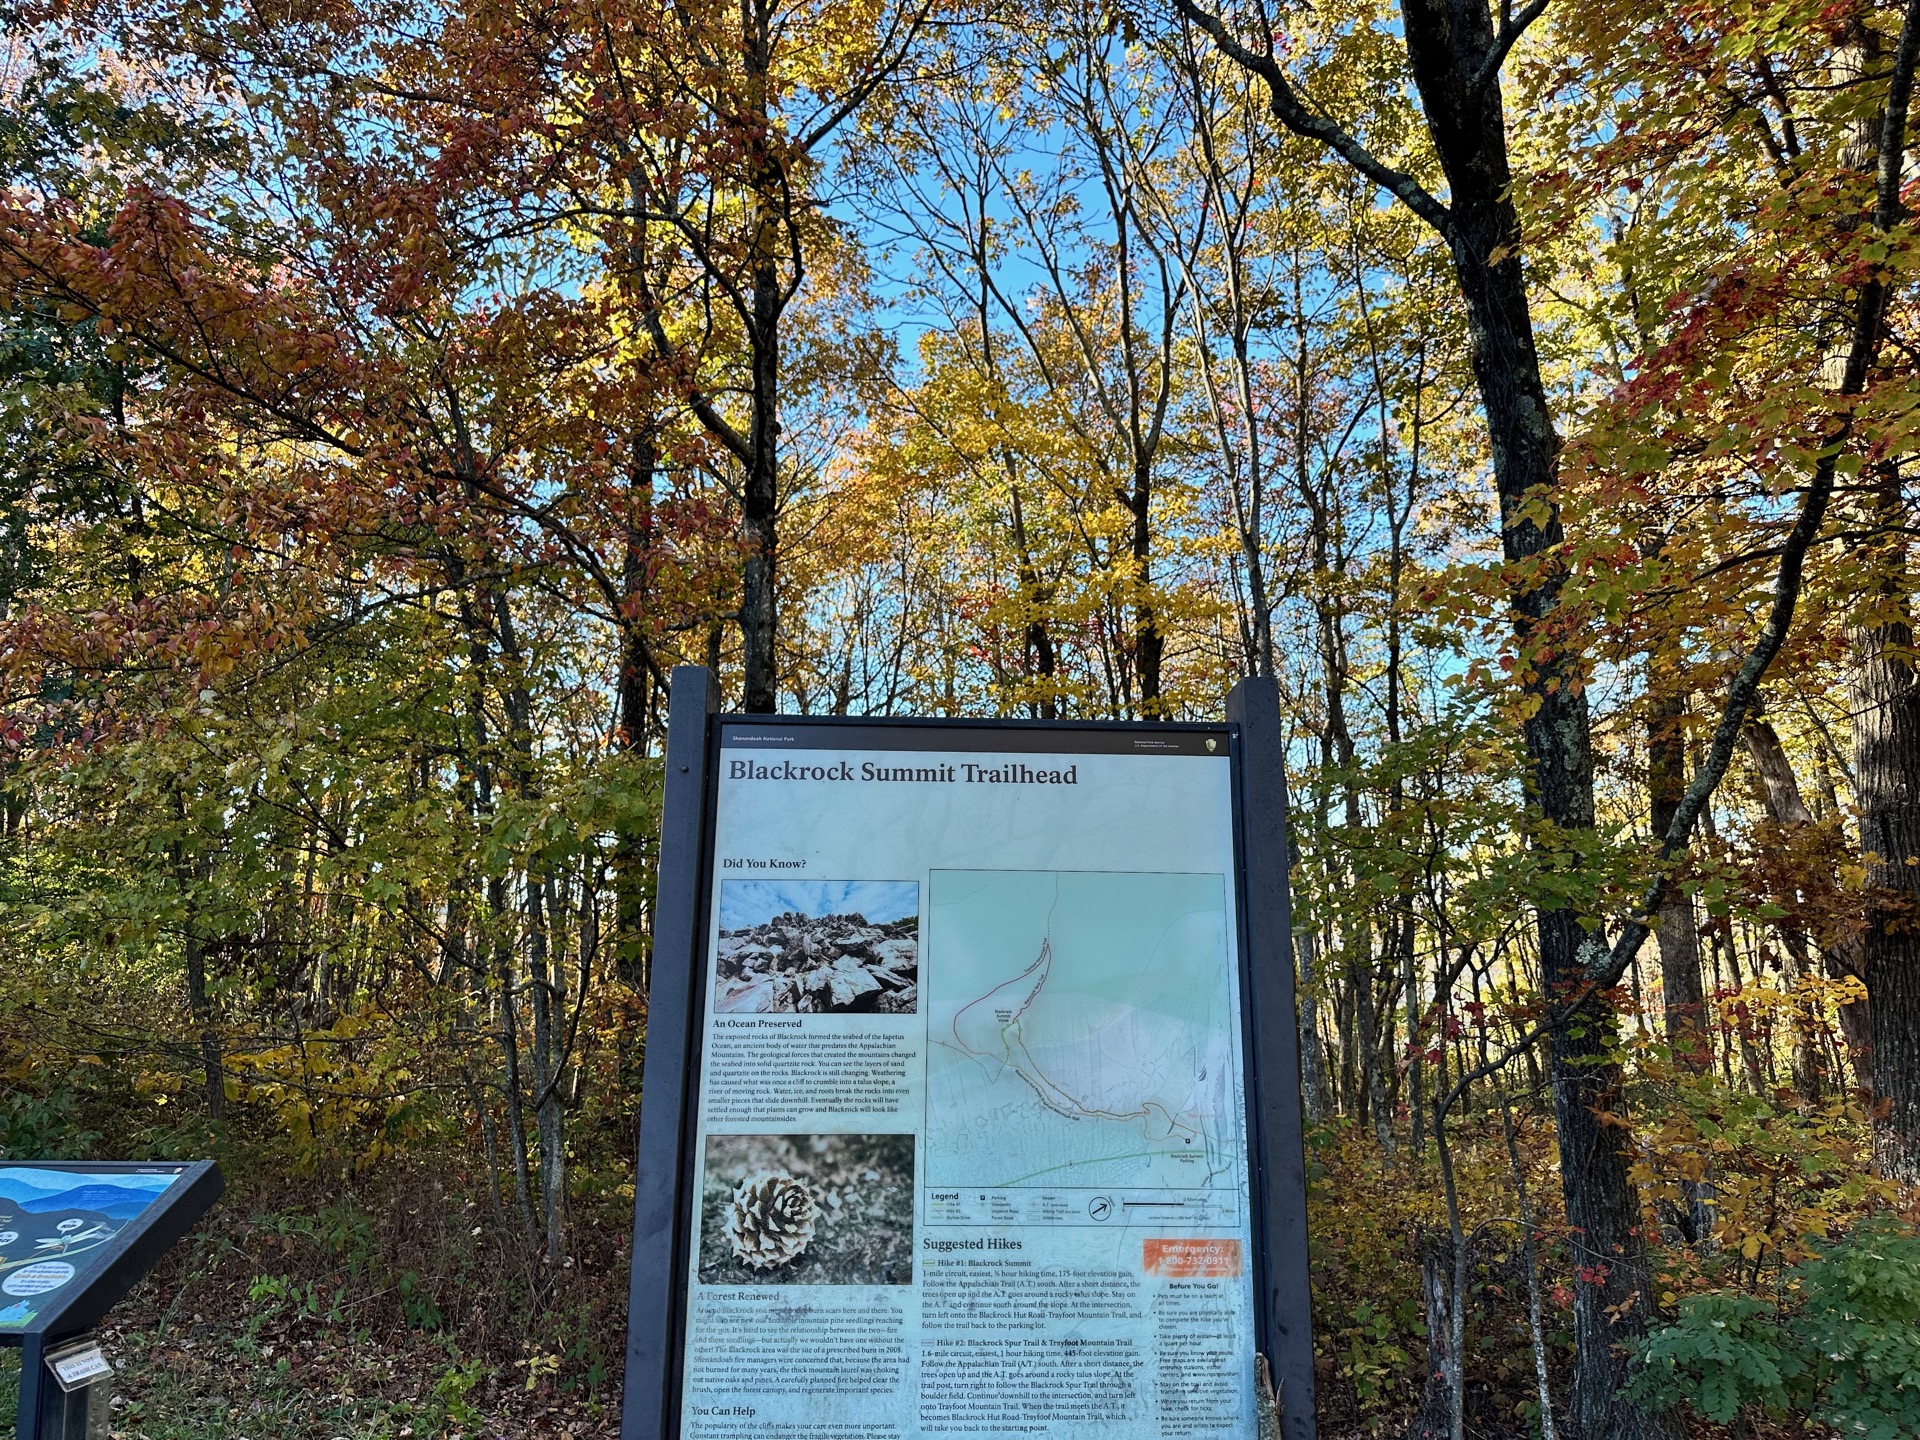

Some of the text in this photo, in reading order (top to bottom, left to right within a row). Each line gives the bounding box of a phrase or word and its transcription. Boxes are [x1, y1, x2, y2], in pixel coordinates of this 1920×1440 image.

[729, 761, 1079, 784] Blackrock Summit Trailhead
[723, 859, 806, 868] Did You Know?
[712, 1019, 802, 1028] An Ocean Preserved
[725, 1033, 750, 1041] exposed
[882, 1034, 904, 1042] Iapetus
[765, 1042, 781, 1050] body
[821, 1042, 847, 1050] predates
[859, 1042, 896, 1051] Appalachian
[759, 1051, 790, 1059] geological
[890, 1051, 916, 1060] changed
[923, 1239, 1022, 1252] Suggested Hikes
[1162, 1245, 1224, 1255] Emergency:
[1158, 1256, 1228, 1264] 1-800-732-0911
[697, 1292, 780, 1300] A Forest Renewed
[1027, 1311, 1075, 1320] Road-Trayfoot
[1008, 1322, 1034, 1330] parking
[1004, 1338, 1021, 1348] Spur
[1049, 1338, 1078, 1348] Trayfoot
[1023, 1350, 1044, 1358] hiking
[73, 1368, 90, 1376] TRASH
[691, 1407, 756, 1418] You Can Help
